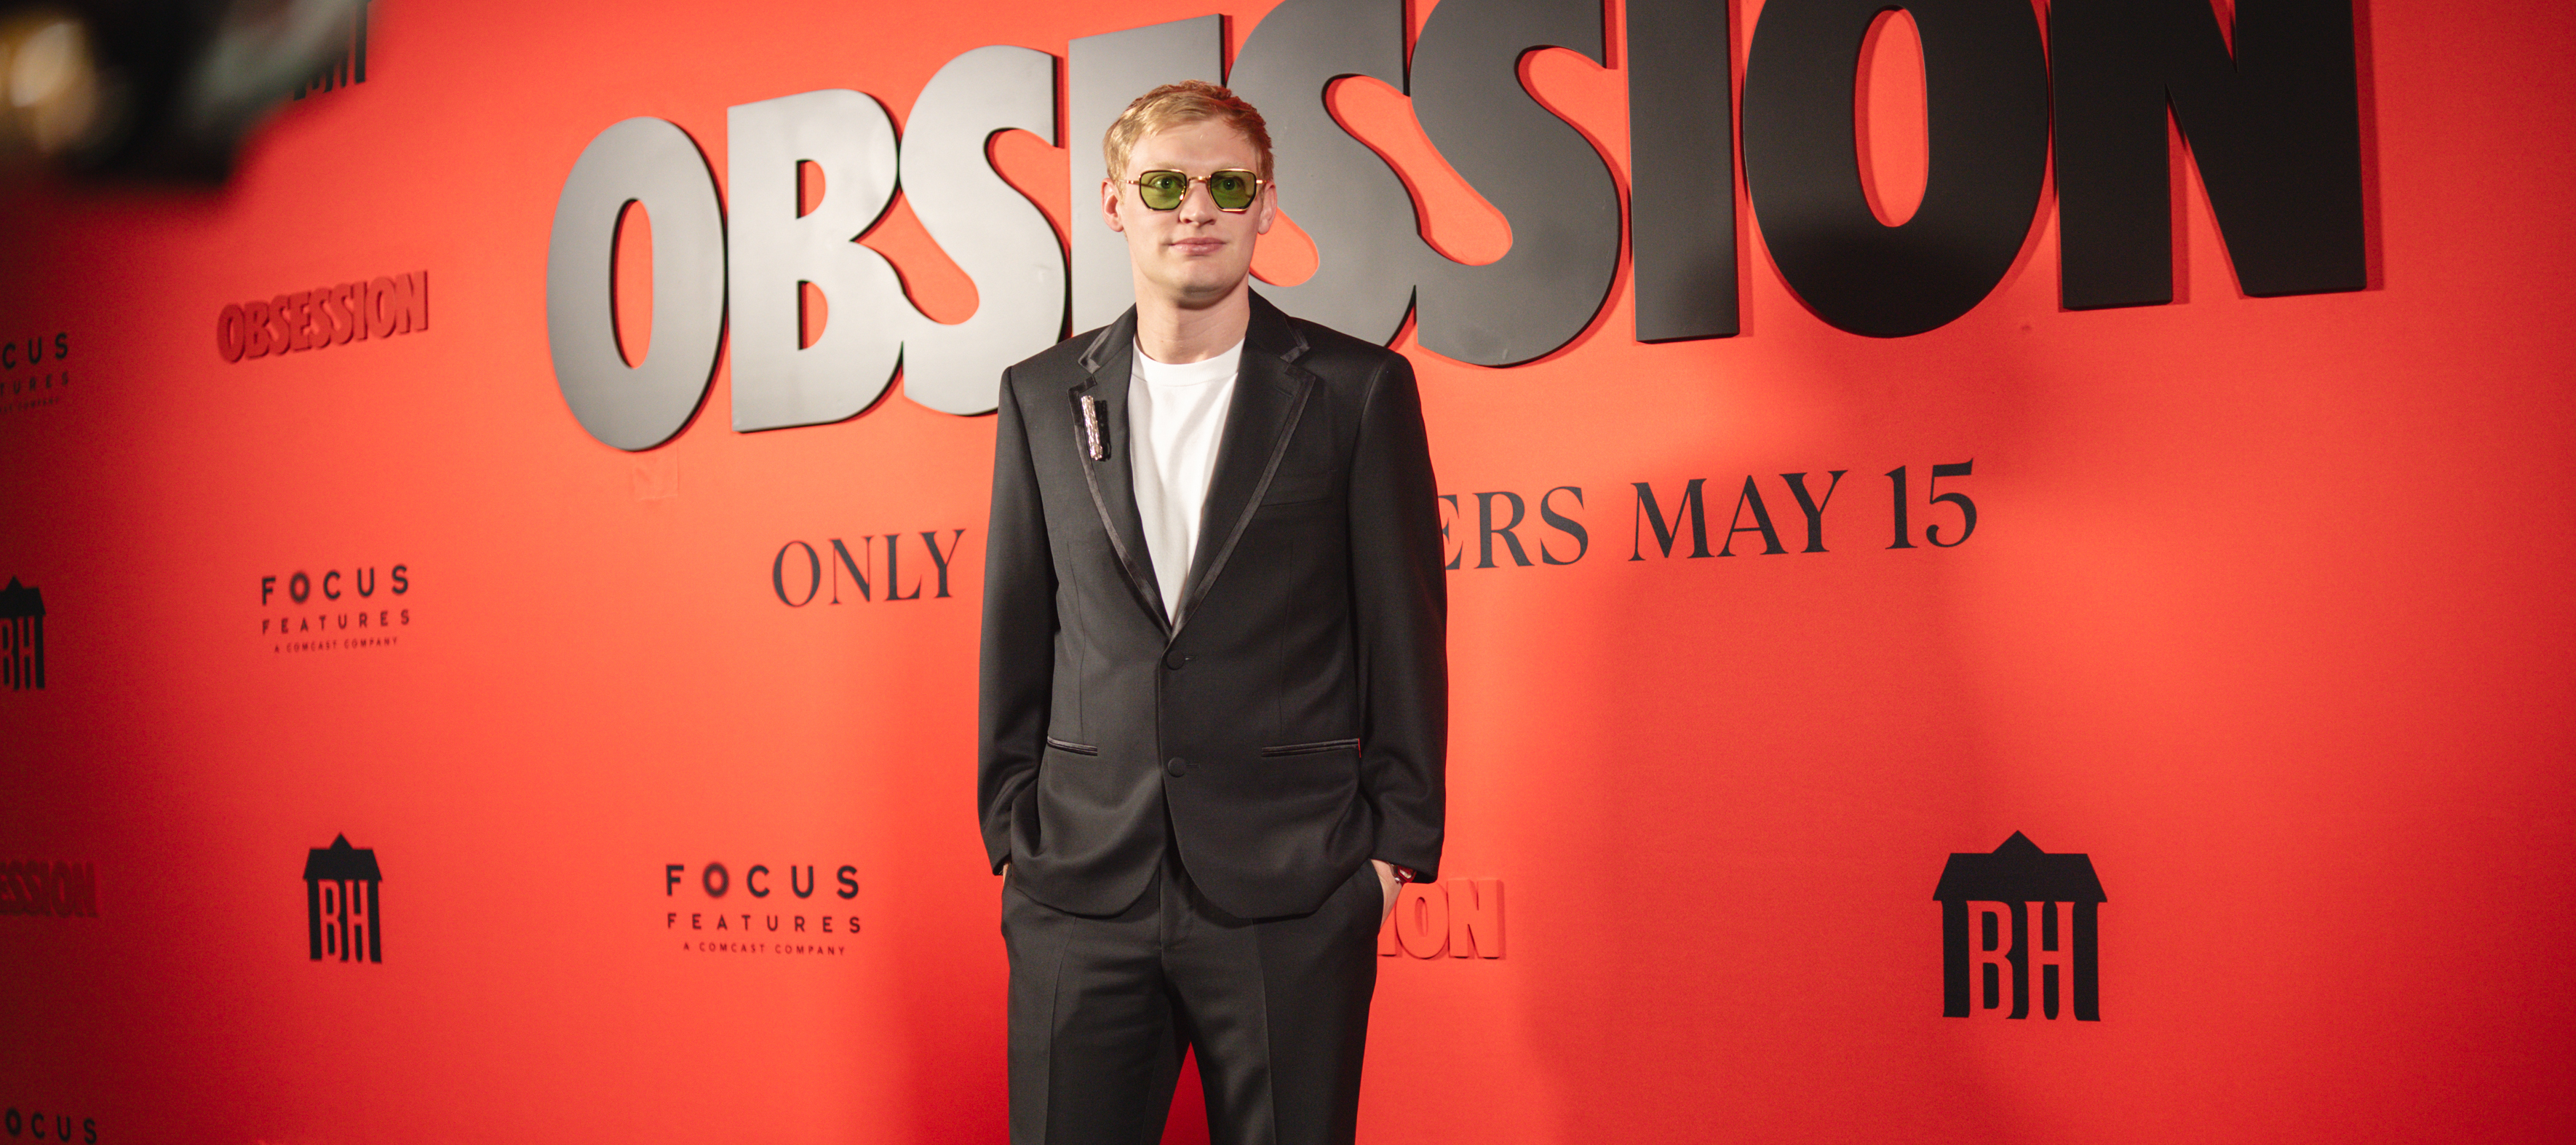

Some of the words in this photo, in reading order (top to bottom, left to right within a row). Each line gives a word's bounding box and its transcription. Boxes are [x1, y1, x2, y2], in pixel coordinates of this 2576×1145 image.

[218, 270, 428, 364] OBSESSION
[772, 528, 966, 607] ONLY
[1628, 470, 1848, 561] MAY
[1884, 457, 1977, 550] 15
[261, 565, 408, 606] FOCUS
[262, 609, 410, 635] FEATURES
[274, 645, 279, 653] A
[287, 641, 338, 652] COMCAST
[344, 637, 397, 649] COMPANY
[666, 862, 859, 900] FOCUS
[317, 879, 371, 962] BH
[667, 912, 861, 933] FEATURES
[683, 942, 689, 951] A
[699, 942, 765, 954] COMCAST
[776, 944, 845, 956] COMPANY
[1966, 900, 2078, 1019] BH
[5, 1107, 97, 1144] OCUS
